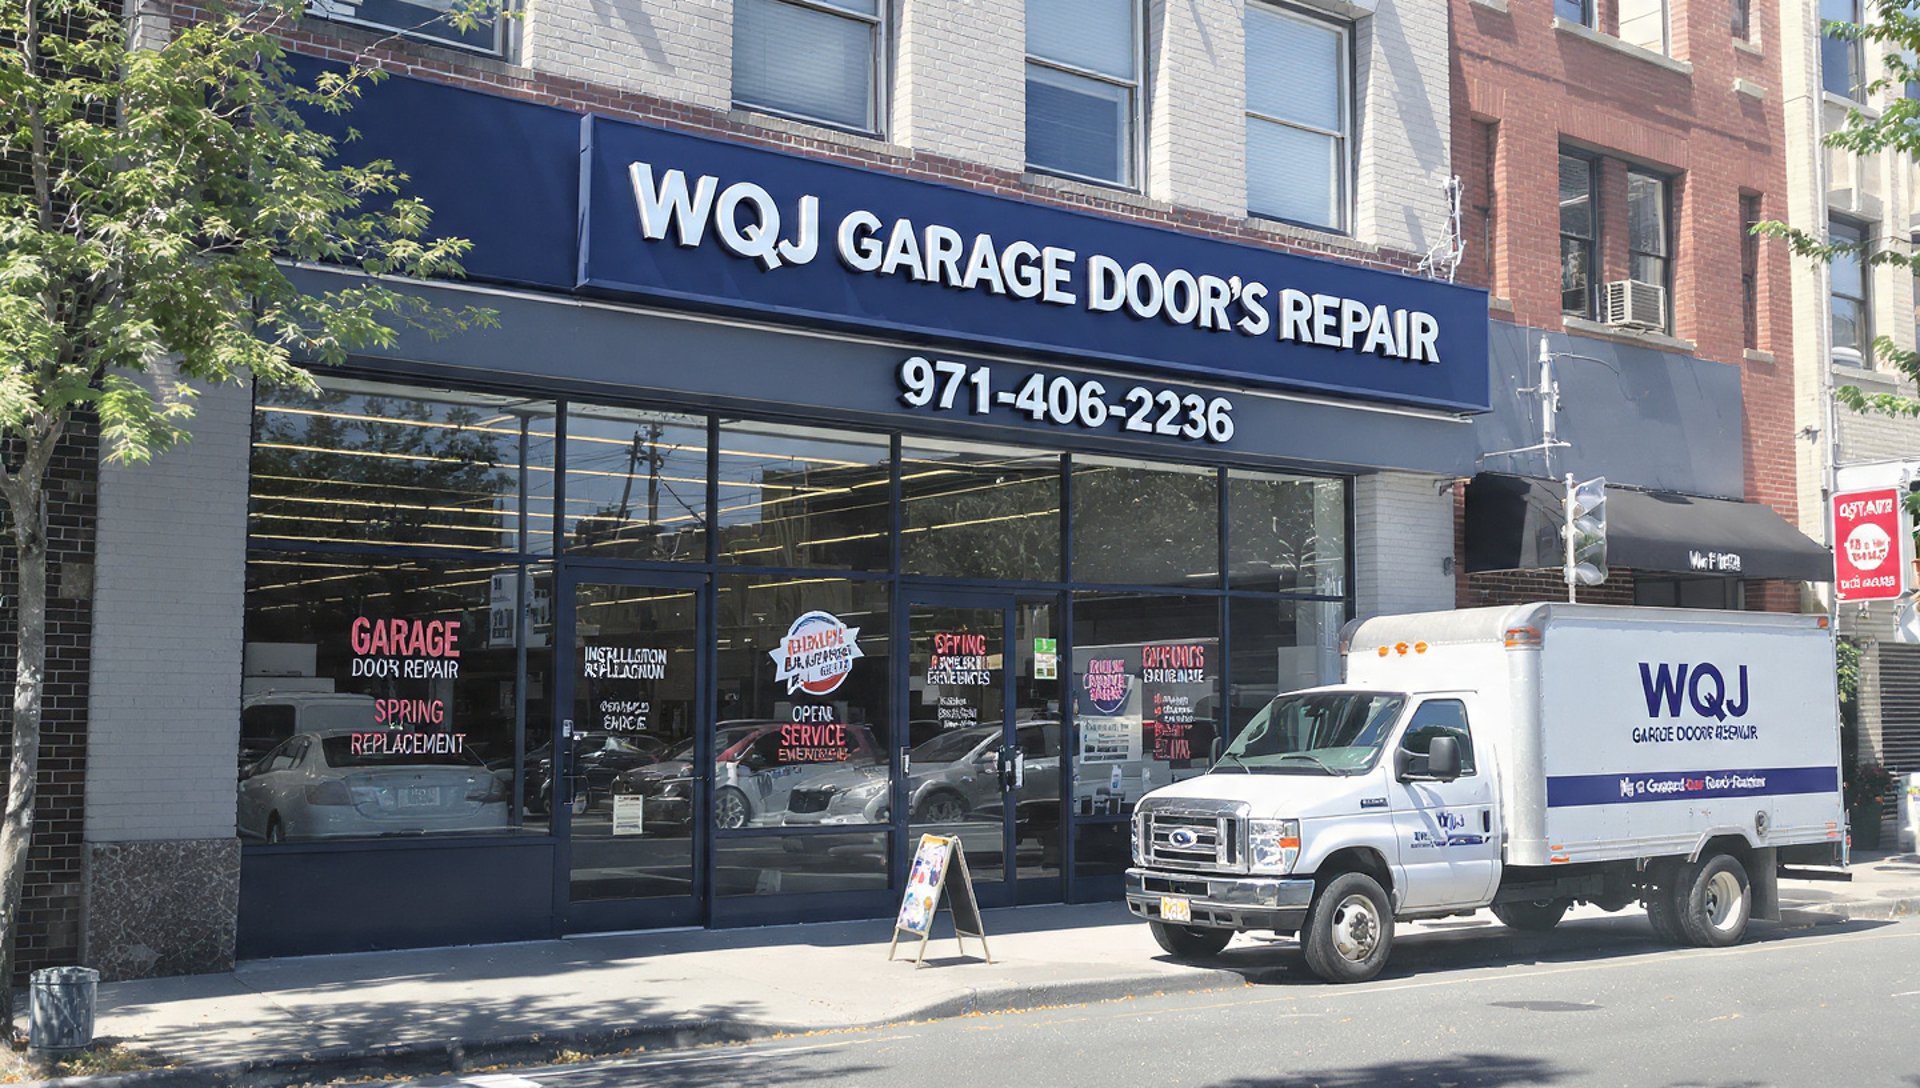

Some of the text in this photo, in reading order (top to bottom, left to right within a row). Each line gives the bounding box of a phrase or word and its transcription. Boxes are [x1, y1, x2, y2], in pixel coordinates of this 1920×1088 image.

[628, 161, 1440, 364] WQJ GARAGE DOOR'S REPAIR
[899, 356, 1234, 443] 971-406-2236
[351, 616, 461, 657] GARAGE
[374, 698, 444, 725] SPRING
[1638, 662, 1750, 722] WQJ
[351, 732, 466, 755] REPLACEMENT
[781, 723, 848, 747] SERVICE
